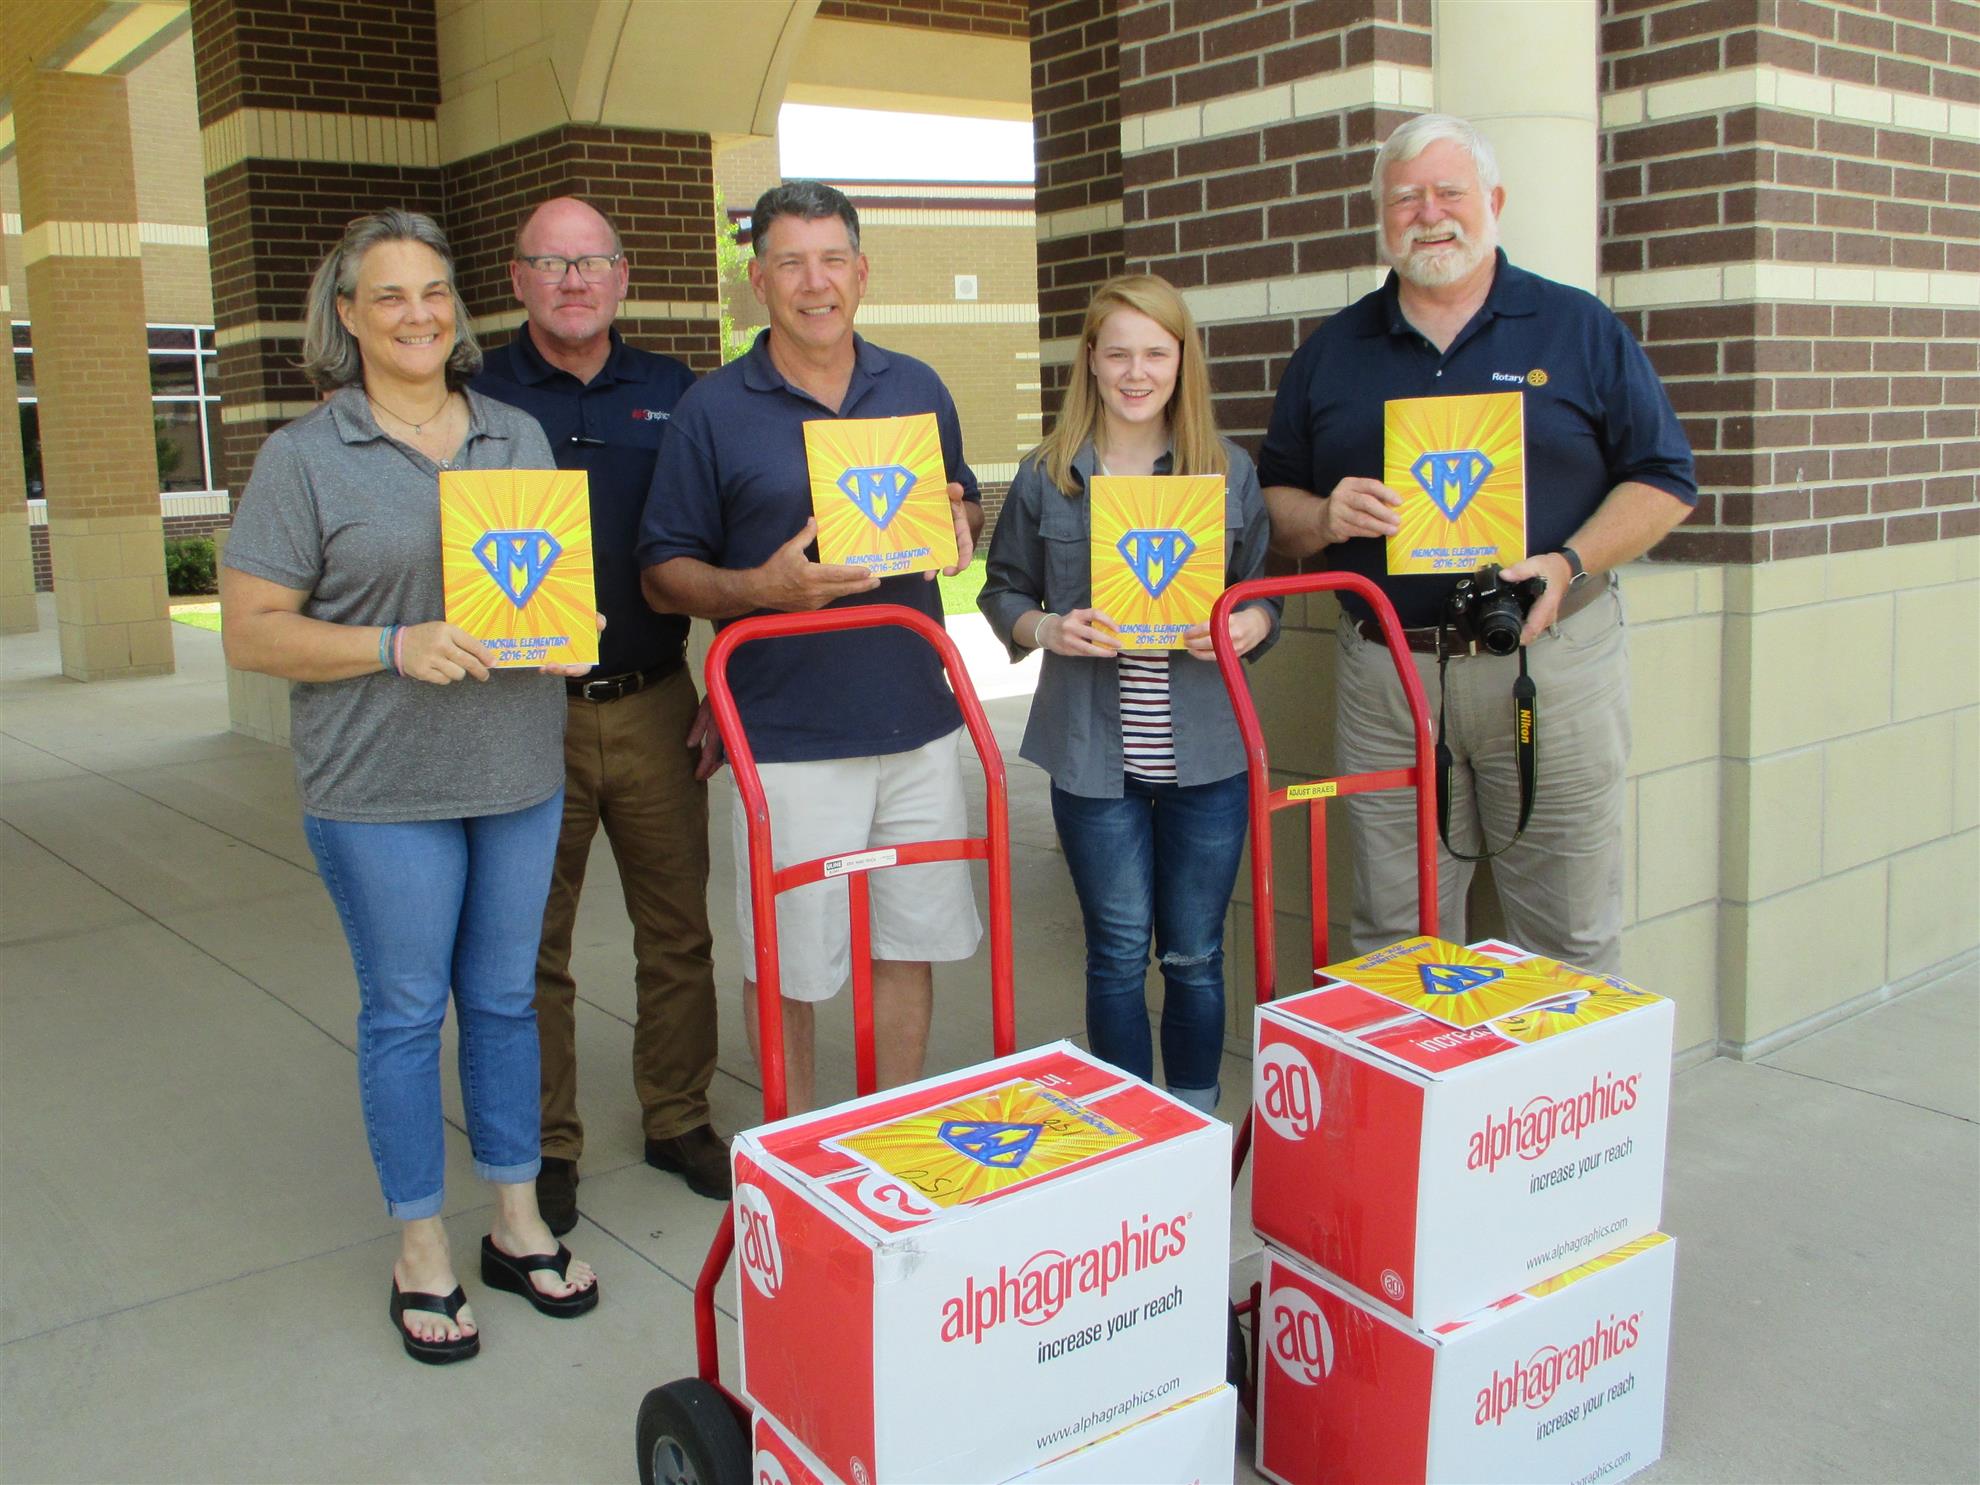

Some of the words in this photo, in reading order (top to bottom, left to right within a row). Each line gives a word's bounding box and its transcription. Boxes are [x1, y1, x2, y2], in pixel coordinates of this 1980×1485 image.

[1492, 372, 1524, 384] Rotary
[845, 553, 884, 565] MEMORIAL
[885, 547, 931, 561] ELEMENTARY
[480, 638, 517, 648] EMORIAL
[520, 636, 569, 647] ELEMENTARY
[499, 649, 547, 661] 2016-2017
[1135, 635, 1177, 645] 2016-2017
[1520, 709, 1531, 744] Nikon
[1264, 1062, 1313, 1137] ag
[1467, 1071, 1637, 1173] alphagraphics
[1530, 1162, 1575, 1194] increase
[1578, 1153, 1601, 1179] your
[1604, 1136, 1633, 1164] reach
[741, 1204, 779, 1295] ag
[1526, 1216, 1628, 1270] www.alphagraphics.com
[940, 1213, 1186, 1345] alphagraphics
[1037, 1323, 1102, 1364] increase
[1106, 1307, 1139, 1341] your
[1143, 1284, 1183, 1320] reach
[1275, 1305, 1327, 1383] ag
[1474, 1313, 1639, 1426] alphagraphics
[1036, 1376, 1181, 1449] www.alphagraphics.com
[1536, 1405, 1580, 1441] increase
[1582, 1393, 1605, 1420] your
[1607, 1371, 1635, 1402] reach
